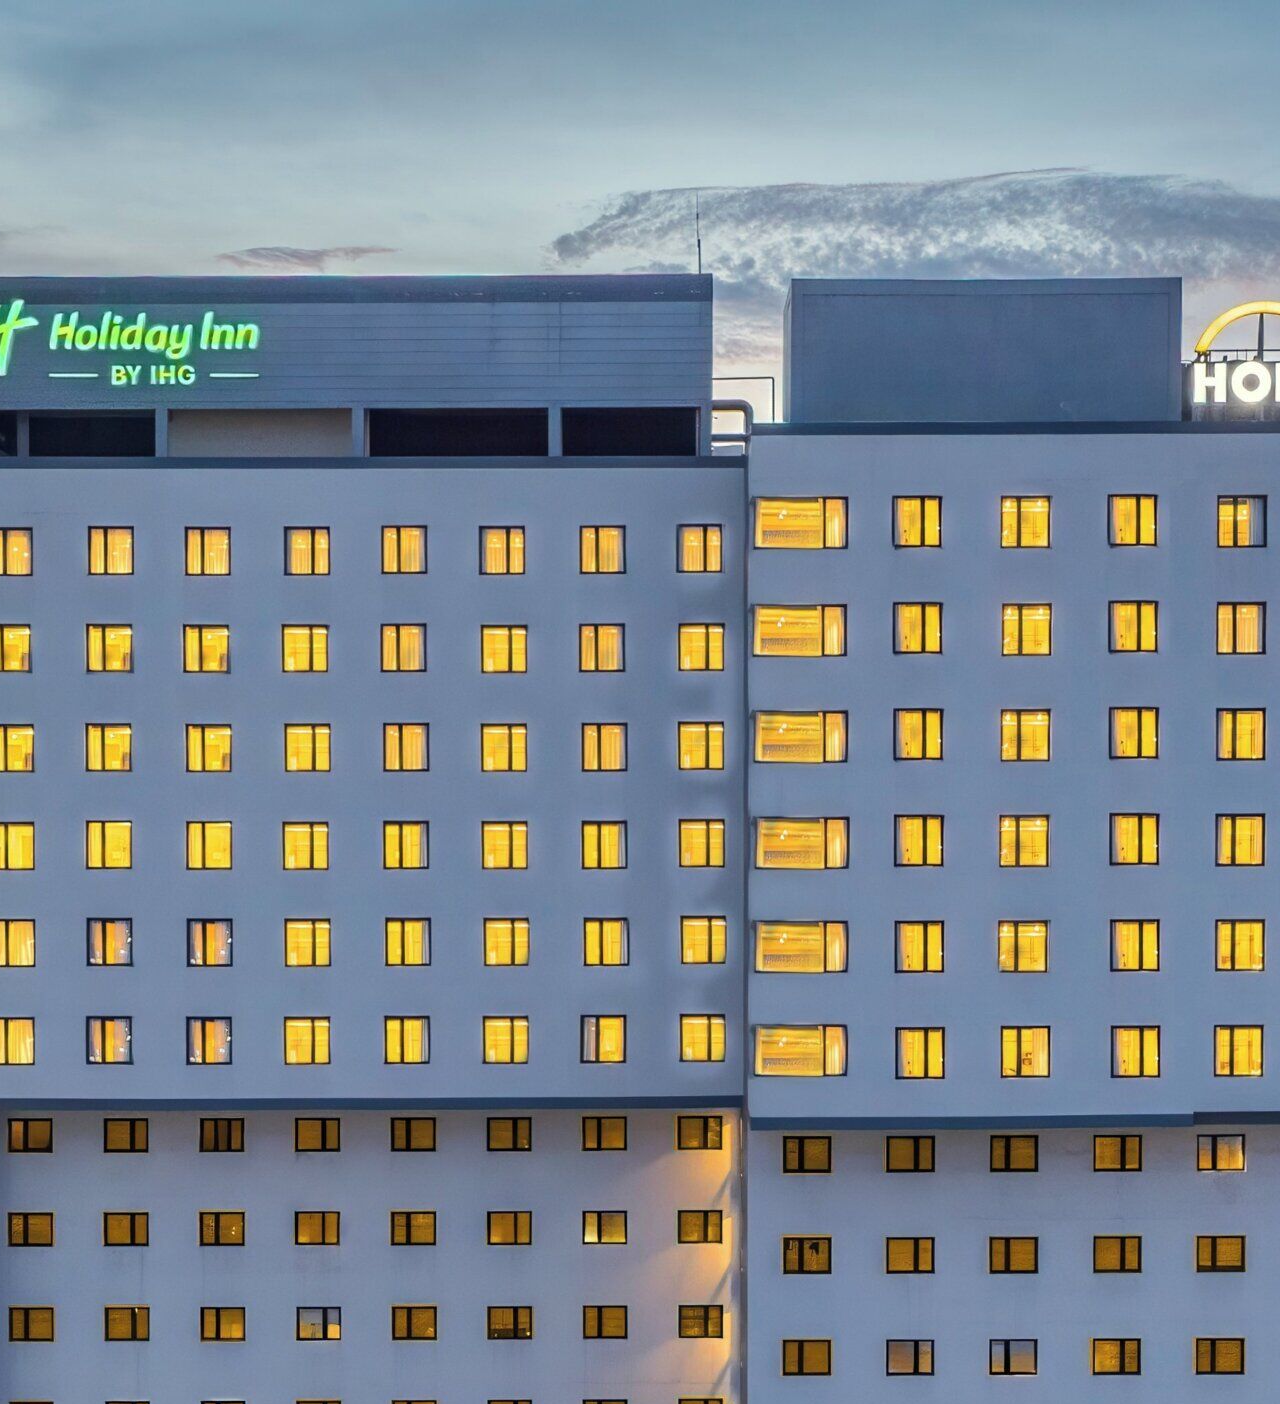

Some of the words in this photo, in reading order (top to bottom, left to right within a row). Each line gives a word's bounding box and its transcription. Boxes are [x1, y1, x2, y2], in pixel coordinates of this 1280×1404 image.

[49, 311, 193, 359] Holiday
[200, 311, 259, 349] Inn
[111, 365, 141, 385] BY
[150, 365, 196, 385] IHG
